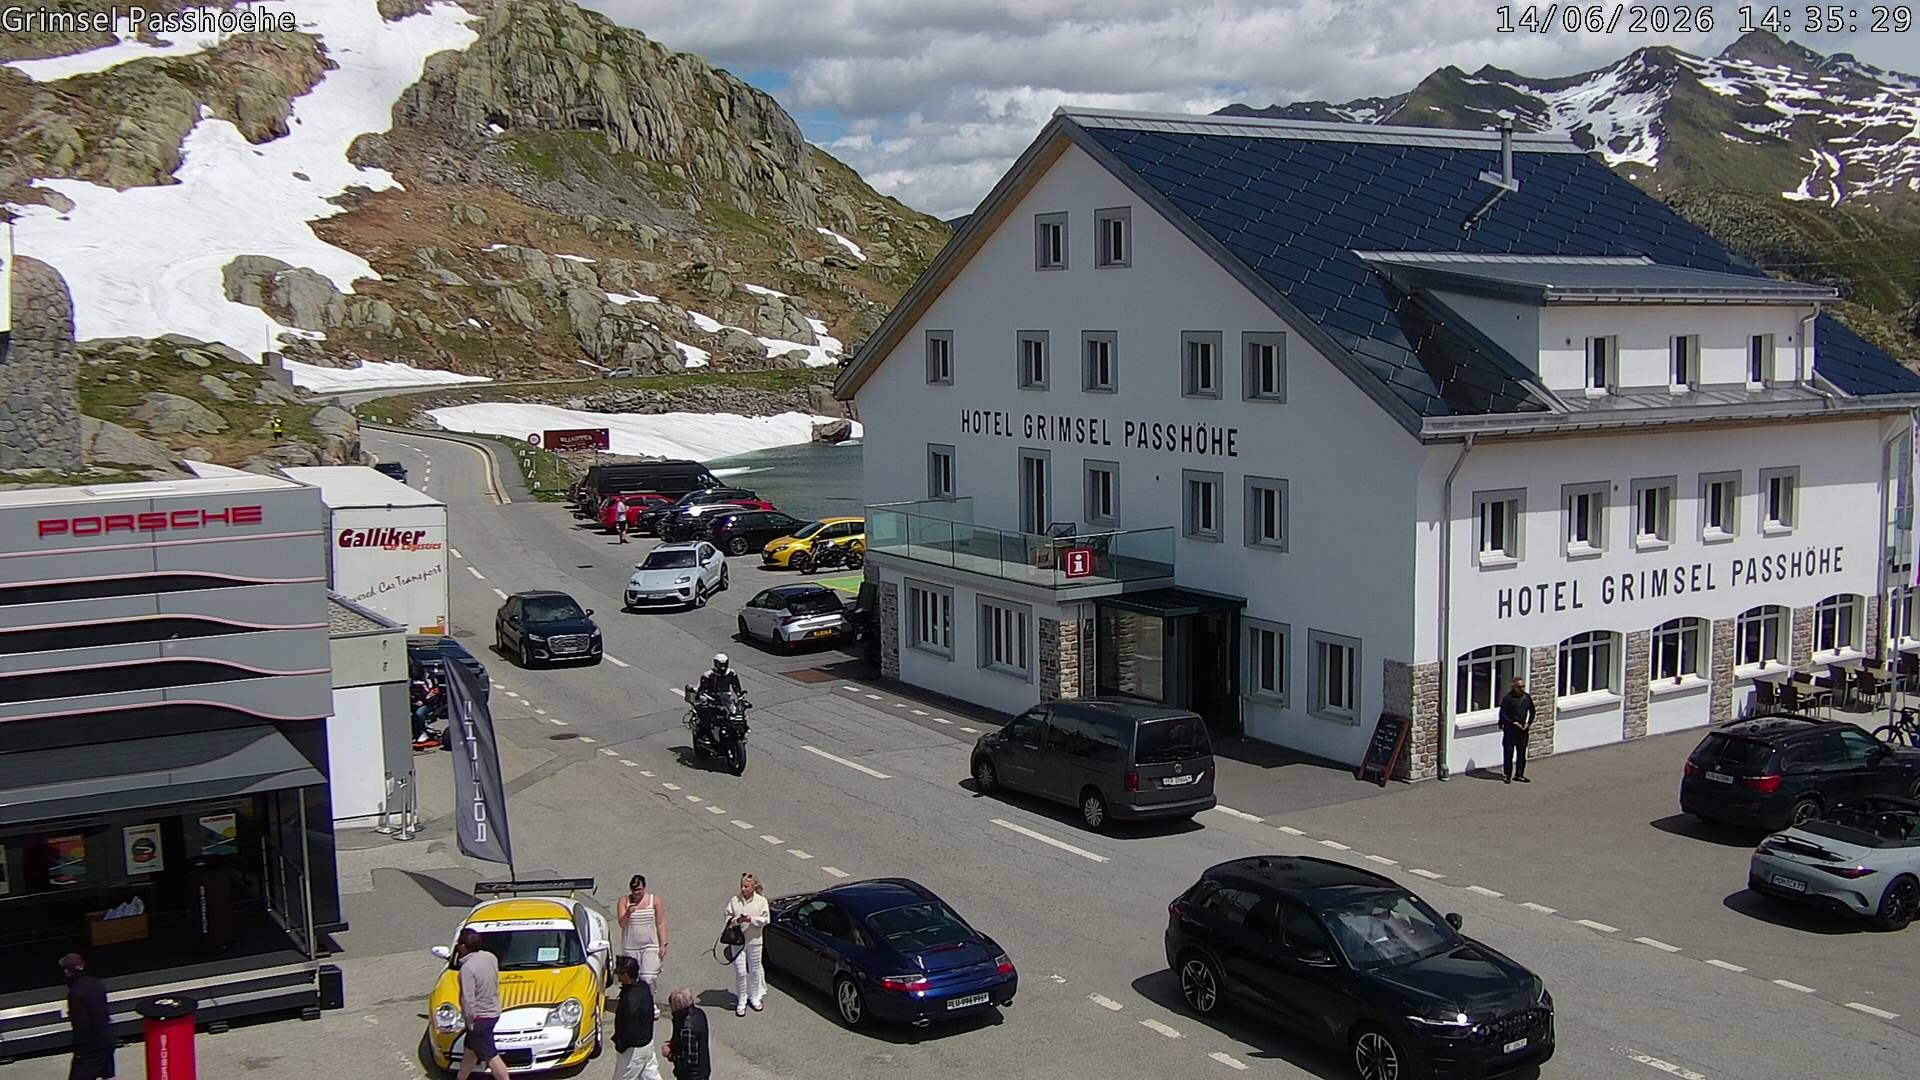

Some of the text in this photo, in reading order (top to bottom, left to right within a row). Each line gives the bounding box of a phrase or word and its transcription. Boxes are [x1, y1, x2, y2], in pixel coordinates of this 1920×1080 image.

[961, 409, 1238, 457] HOTEL GRIMSEL PASSHÖHE
[37, 505, 263, 539] PORSCHE
[338, 527, 426, 548] Galliker
[1498, 546, 1844, 619] HOTEL GRIMSEL PASSHÖHE
